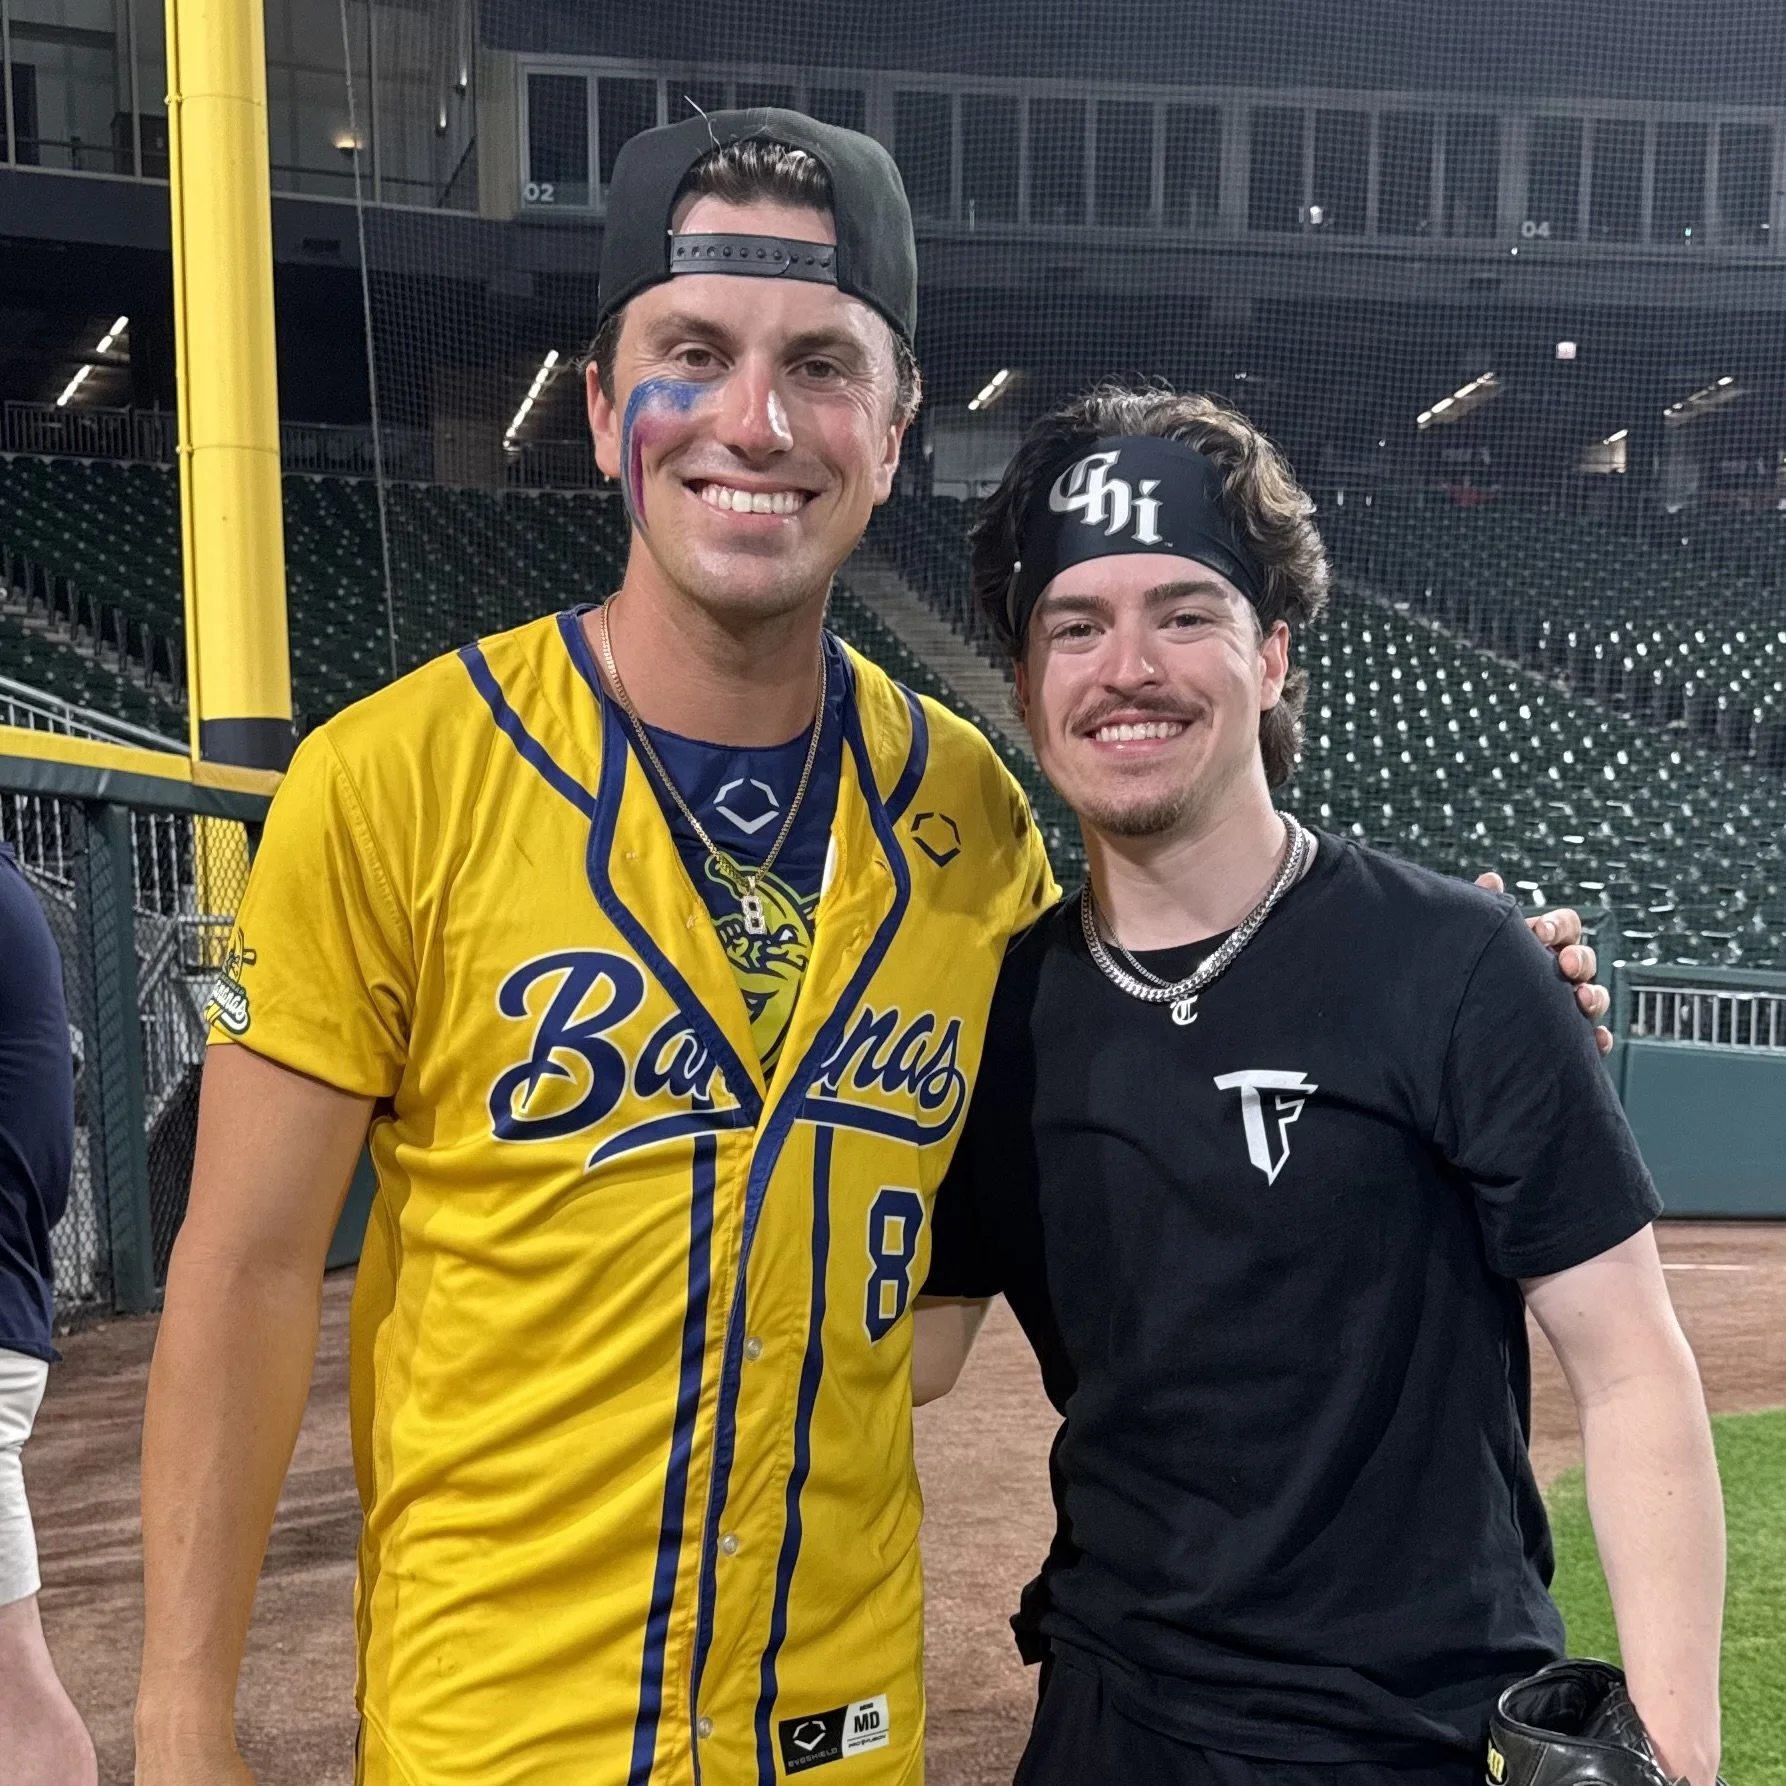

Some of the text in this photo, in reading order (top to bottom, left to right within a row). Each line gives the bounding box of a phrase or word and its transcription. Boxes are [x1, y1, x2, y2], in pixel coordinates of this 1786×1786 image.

[525, 183, 554, 201] 02
[1521, 221, 1550, 238] 04
[1049, 450, 1163, 545] Chi
[741, 896, 767, 934] 8
[488, 948, 967, 1173] Banas
[863, 1184, 926, 1347] 8
[854, 1711, 880, 1733] MD
